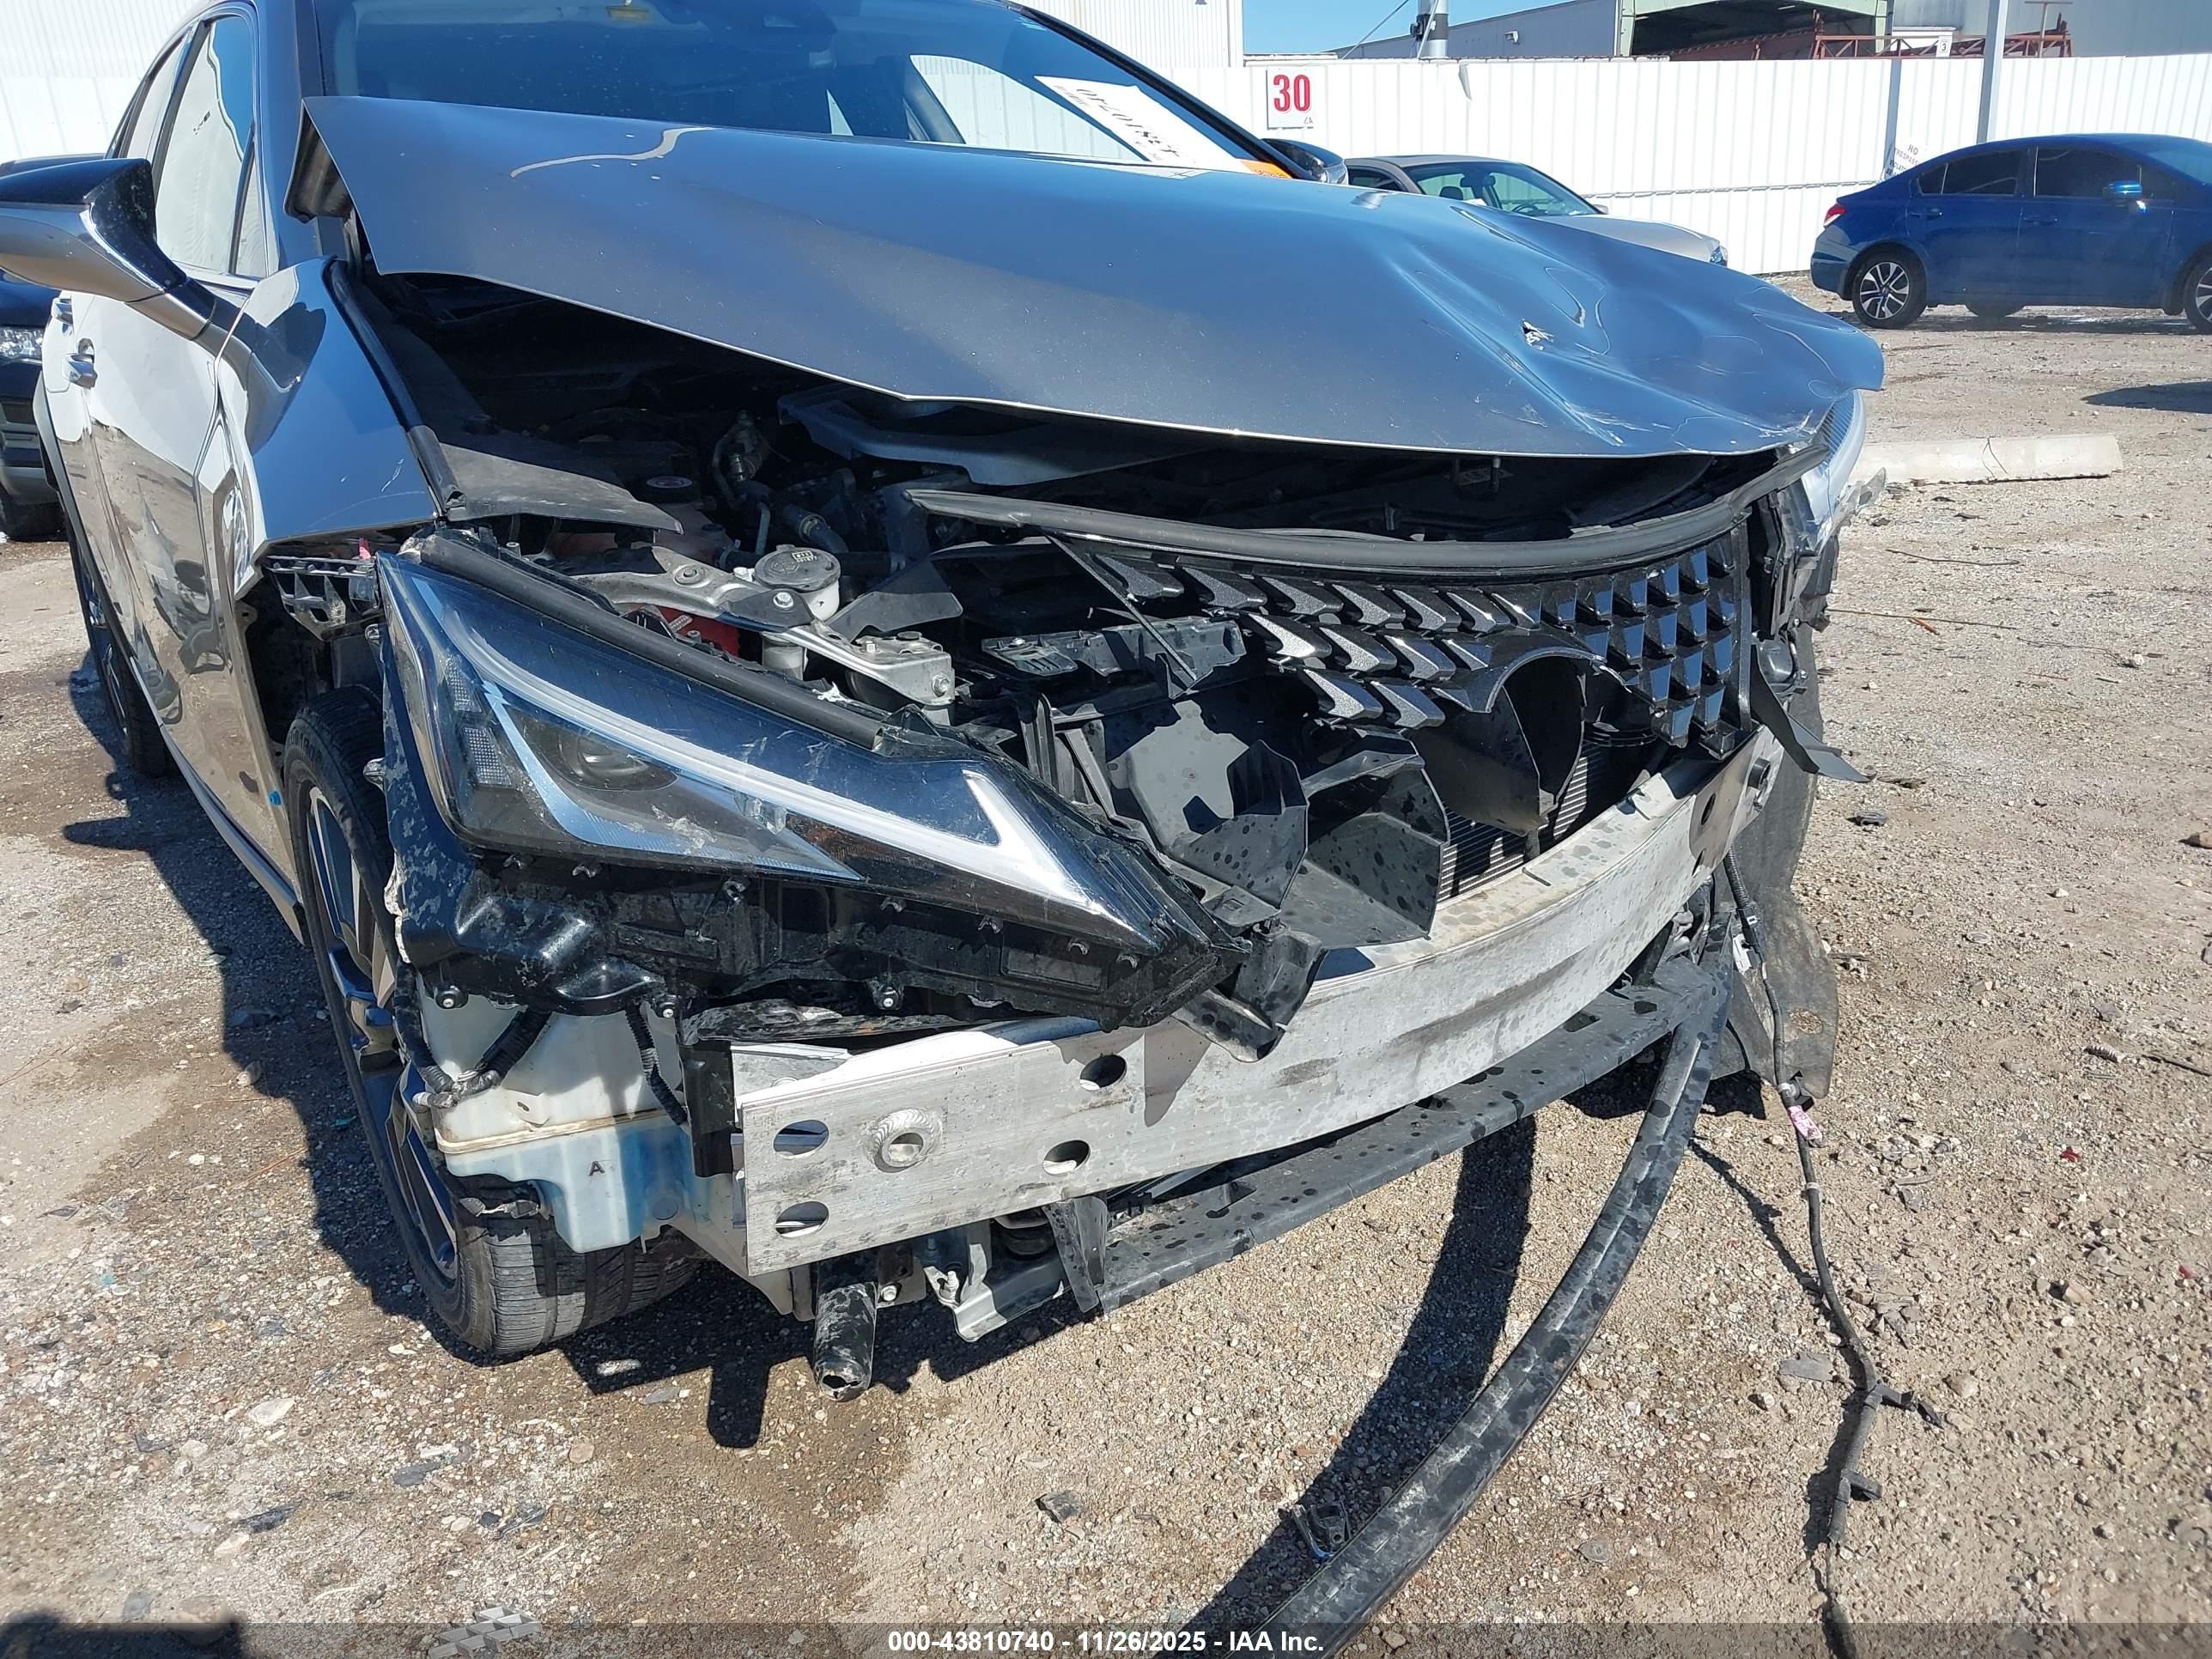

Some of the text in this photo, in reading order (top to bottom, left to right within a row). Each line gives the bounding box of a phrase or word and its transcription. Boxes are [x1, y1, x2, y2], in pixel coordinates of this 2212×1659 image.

[1273, 74, 1310, 112] 30
[1907, 143, 1919, 155] NO
[588, 1160, 605, 1176] A
